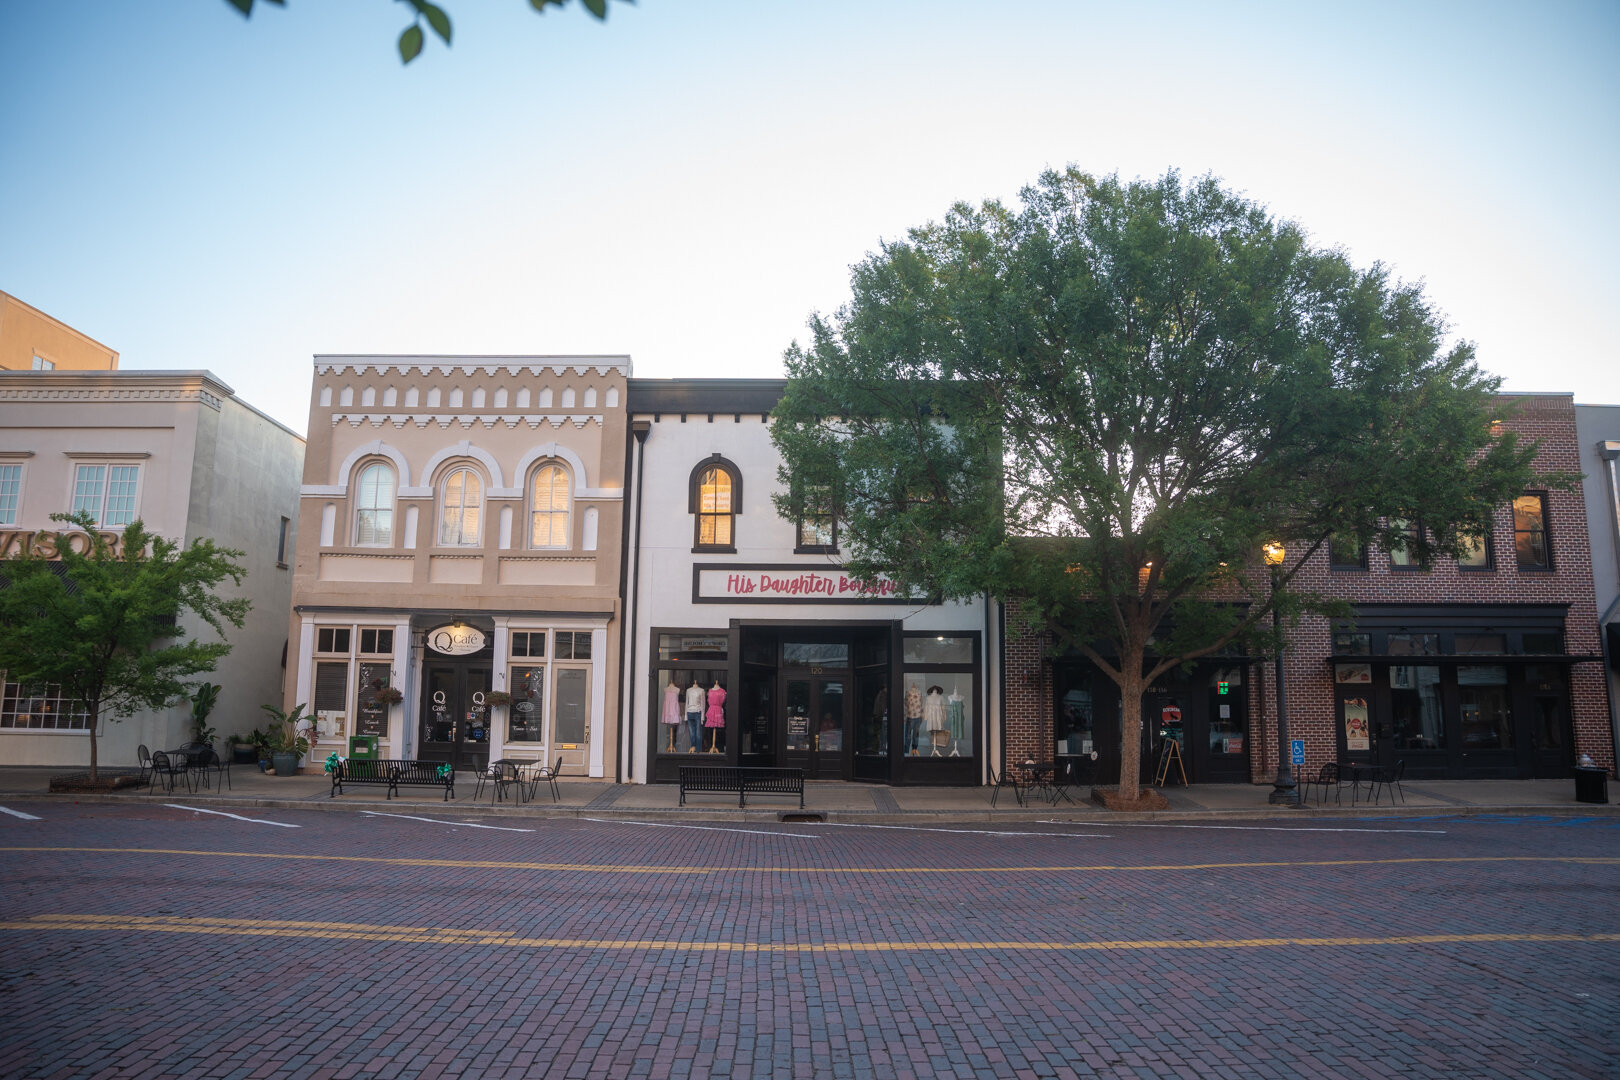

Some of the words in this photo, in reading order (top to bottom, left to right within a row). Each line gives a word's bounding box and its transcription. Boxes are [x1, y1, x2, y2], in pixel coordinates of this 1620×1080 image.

[727, 574, 757, 595] His
[760, 573, 836, 596] Daughter
[434, 631, 453, 652] Q
[453, 633, 478, 645] Café
[811, 667, 823, 675] 120
[433, 690, 446, 704] Q
[472, 691, 485, 705] Q
